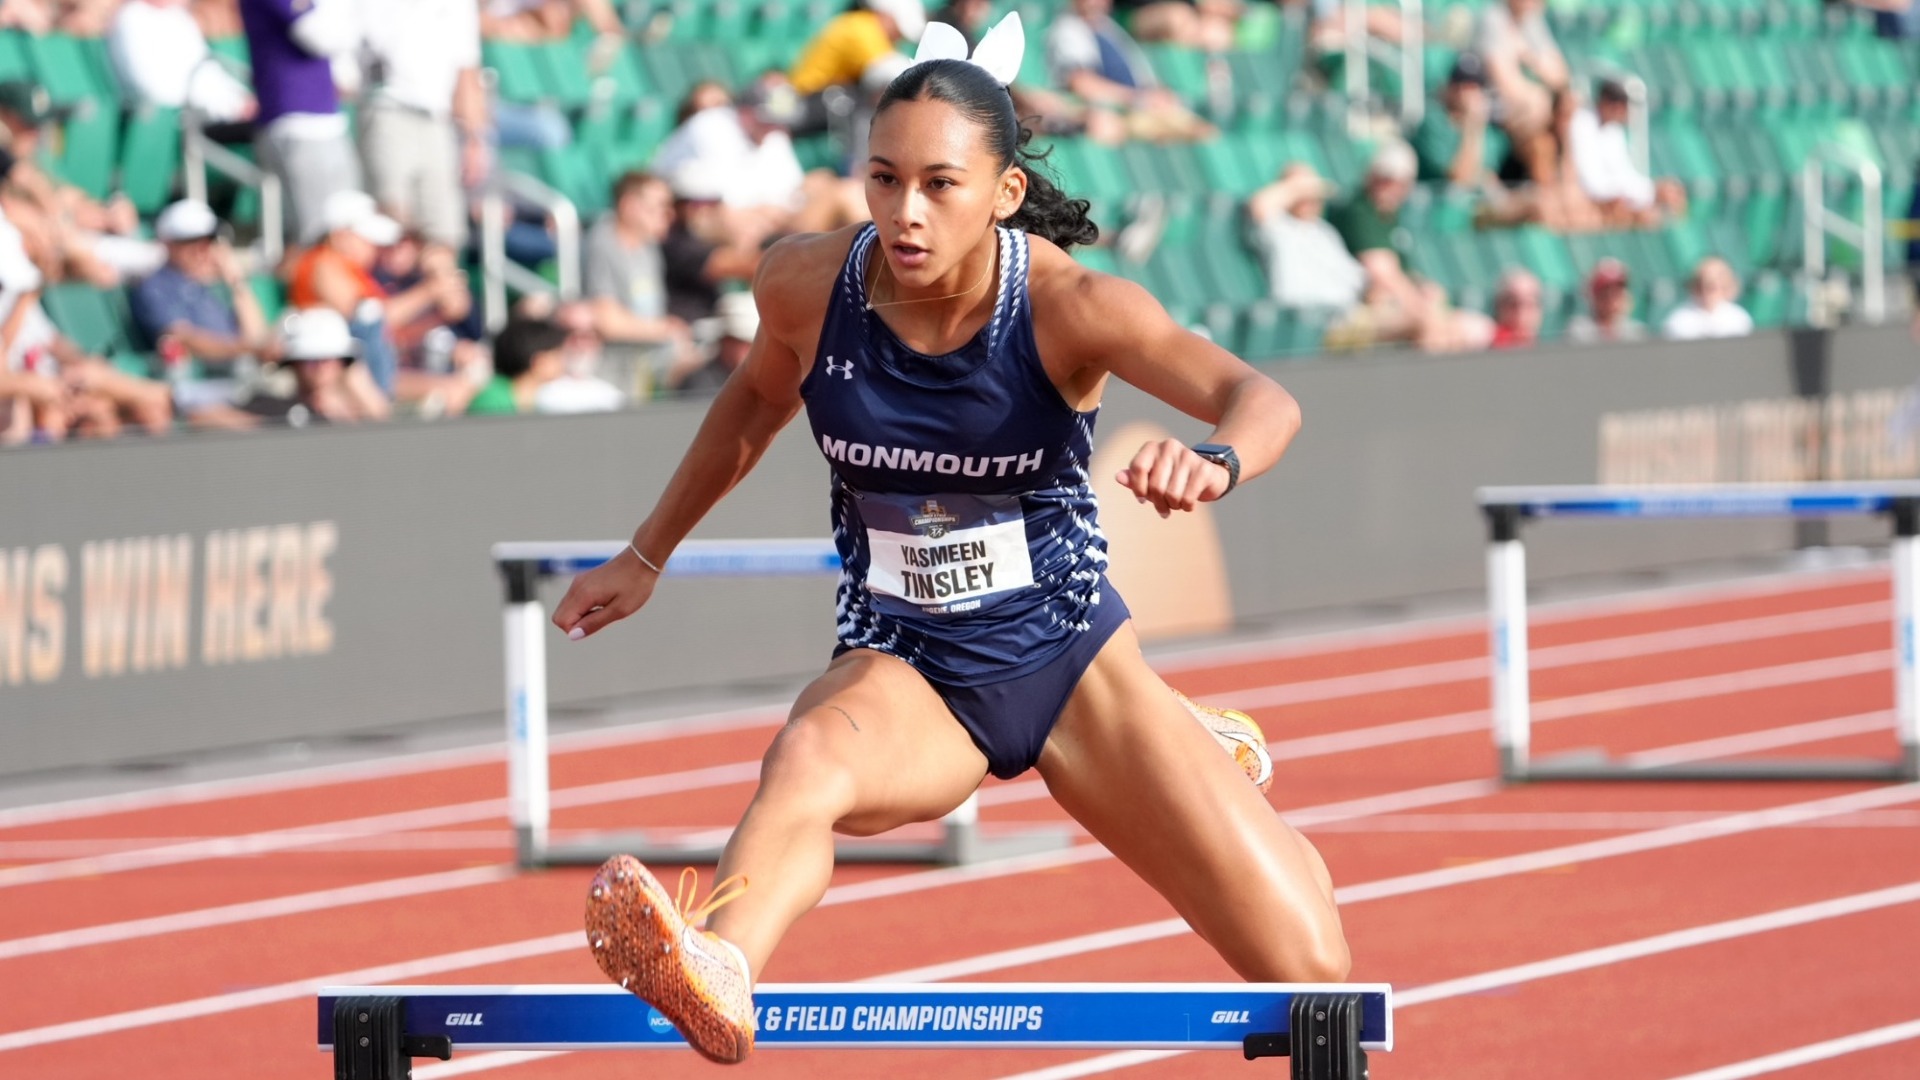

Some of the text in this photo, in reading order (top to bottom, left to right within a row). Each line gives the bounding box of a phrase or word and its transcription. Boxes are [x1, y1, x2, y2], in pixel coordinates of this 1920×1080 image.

[822, 434, 1044, 477] MONMOUTH
[901, 540, 986, 568] YASMEEN
[901, 562, 994, 599] TINSLEY
[82, 532, 193, 679] WIN
[203, 519, 338, 666] HERE
[951, 599, 981, 613] OREGON
[445, 1013, 484, 1026] GILL
[765, 1006, 782, 1031] &
[785, 1006, 847, 1031] FIELD
[852, 1005, 1043, 1031] CHAMPIONSHIPS
[1211, 1010, 1251, 1024] GILL
